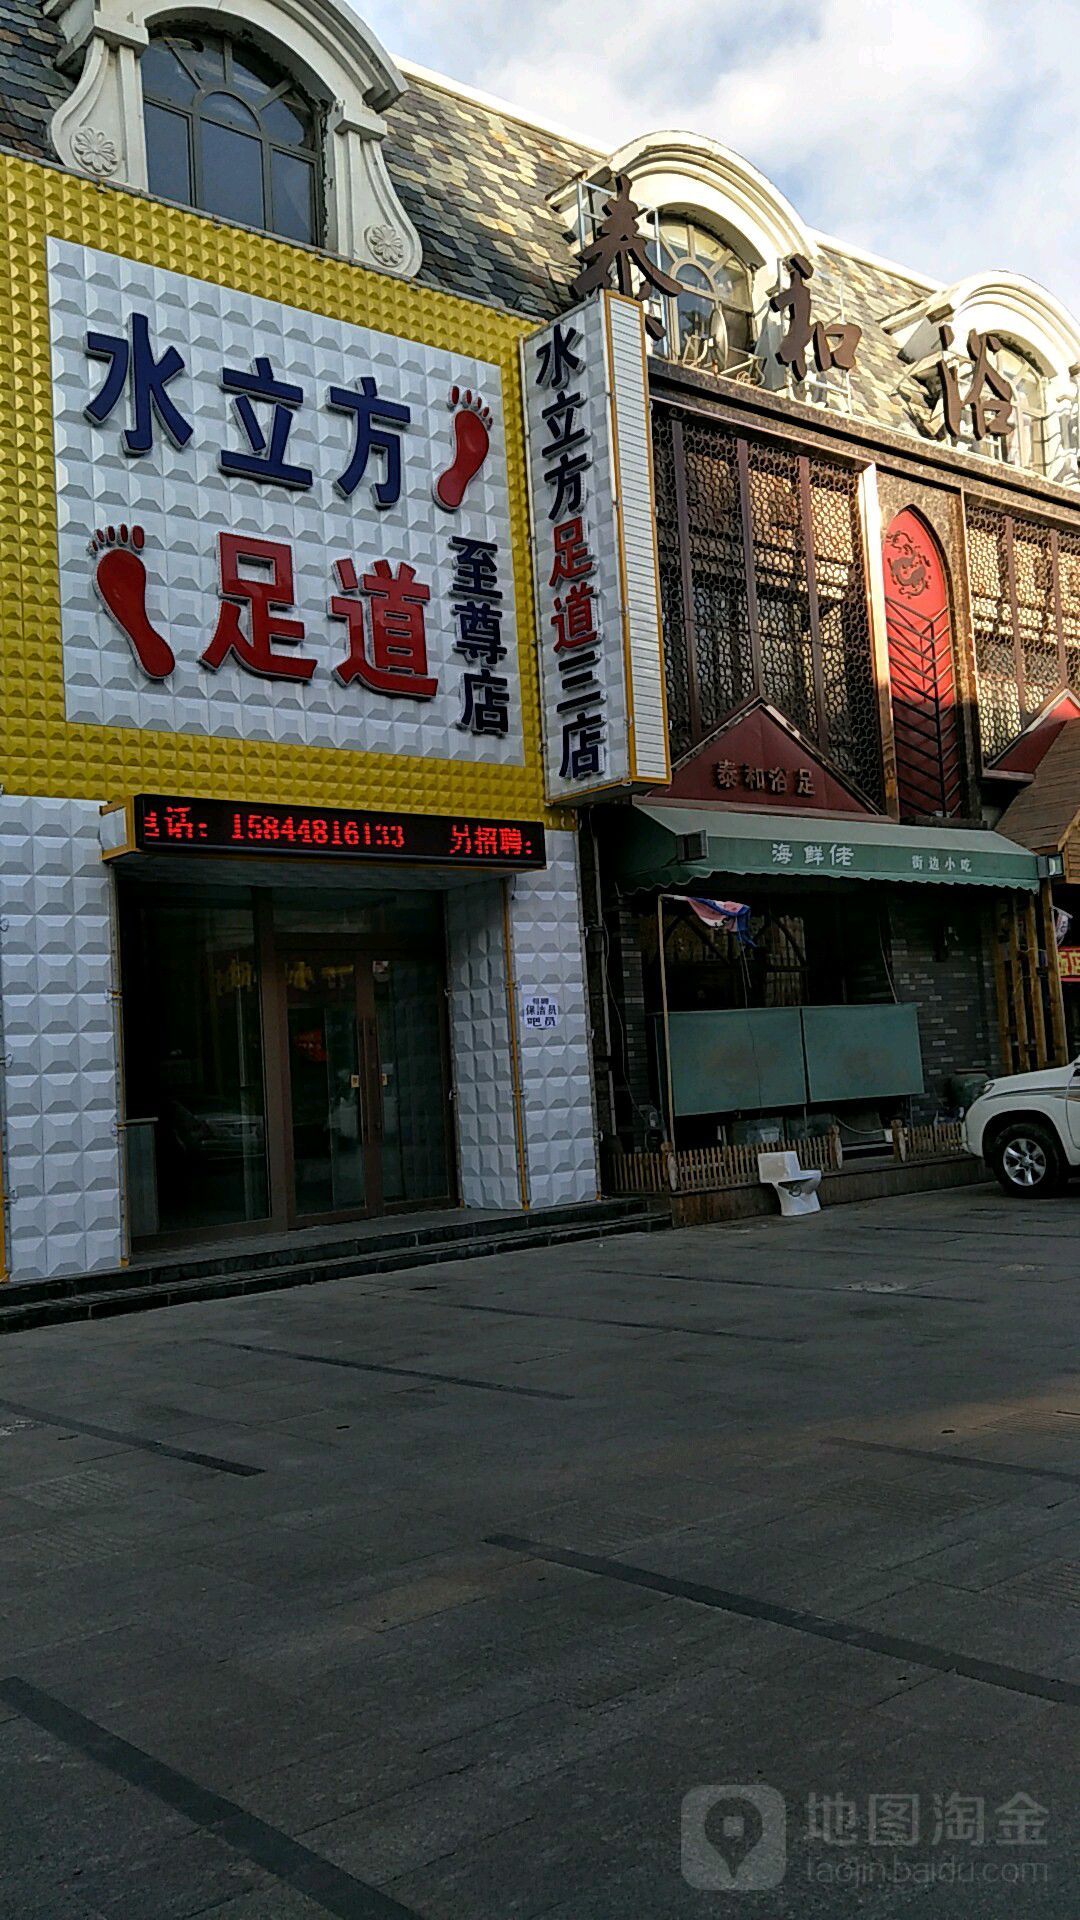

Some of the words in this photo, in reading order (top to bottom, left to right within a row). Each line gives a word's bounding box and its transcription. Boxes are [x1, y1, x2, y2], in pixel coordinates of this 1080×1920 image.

[83, 312, 412, 510] 水立方
[199, 531, 440, 700] 足道
[535, 323, 606, 779] 水立方足道三店
[450, 536, 510, 737] 至尊店
[232, 813, 405, 848] 15844816133
[771, 843, 854, 867] 海鲜佬
[911, 855, 973, 873] 街边小吃
